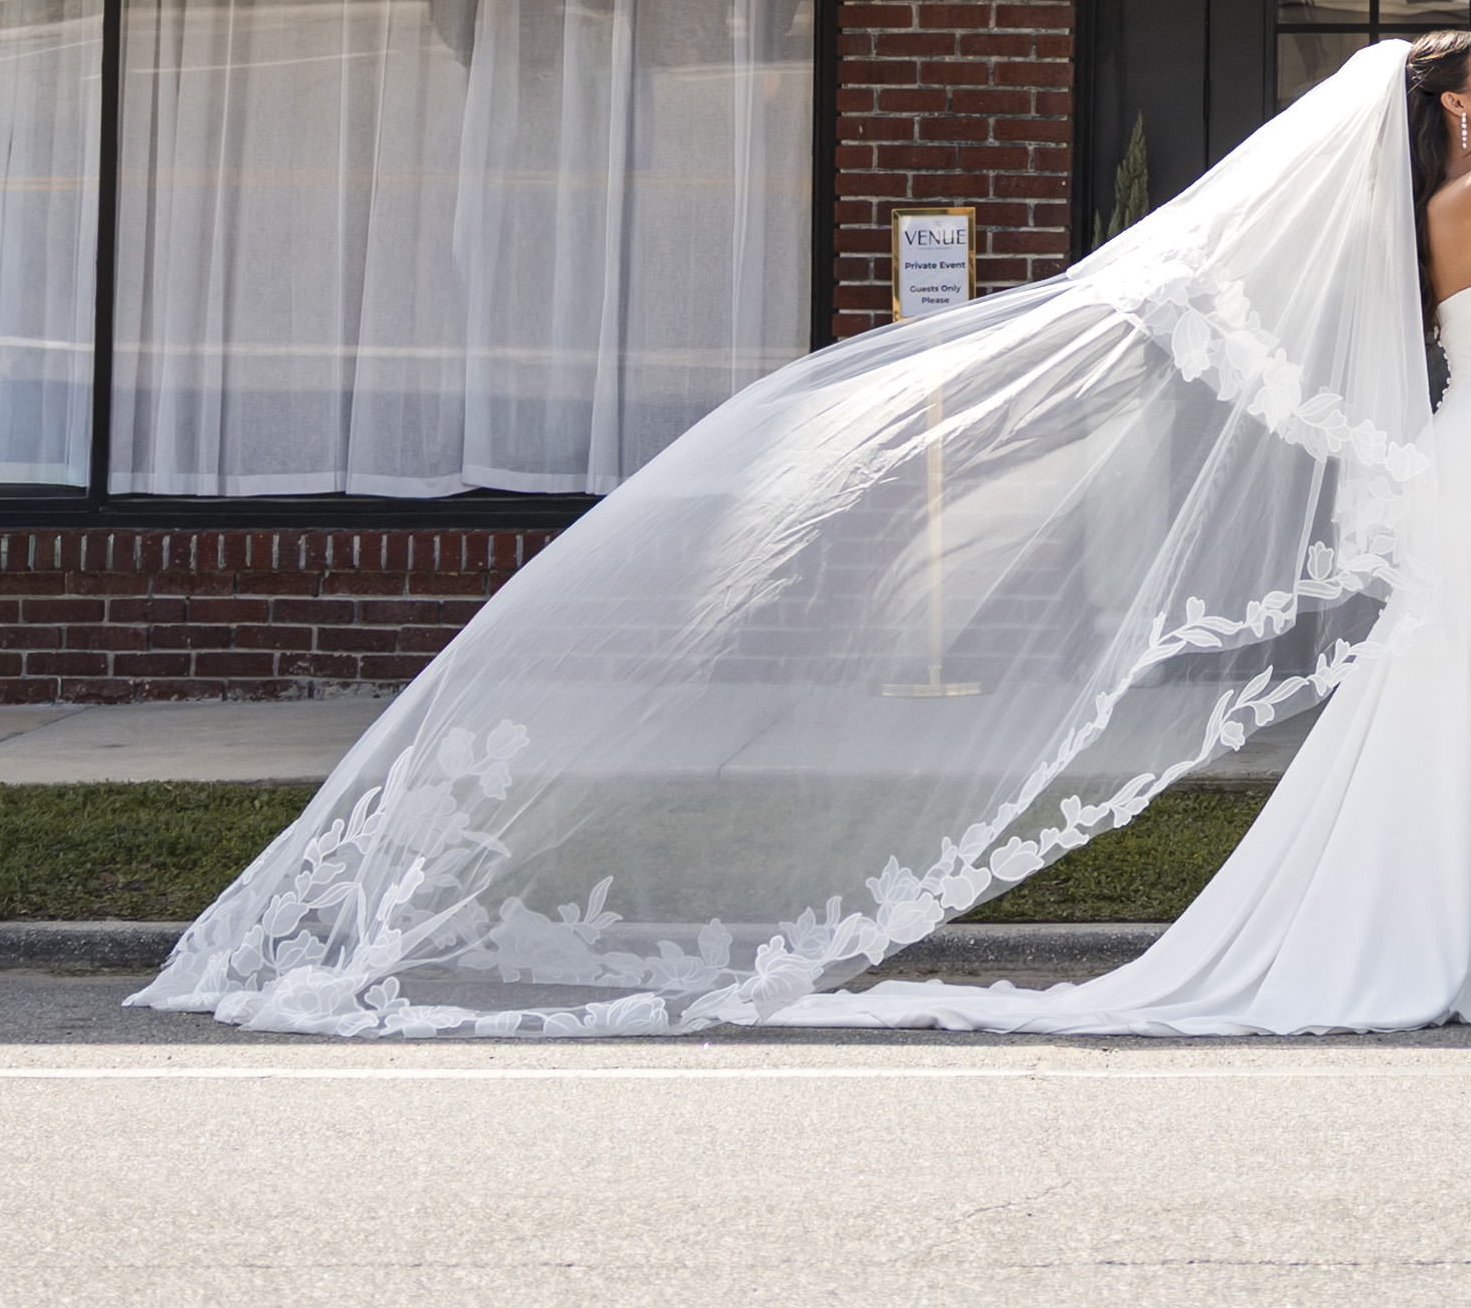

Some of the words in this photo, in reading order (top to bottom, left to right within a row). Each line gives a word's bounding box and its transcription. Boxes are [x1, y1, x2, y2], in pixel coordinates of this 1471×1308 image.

[904, 229, 966, 246] VENUE
[904, 261, 937, 270] Private
[939, 261, 966, 269] Event
[909, 285, 939, 293] Guests
[940, 284, 961, 293] Only
[921, 296, 950, 304] Please
